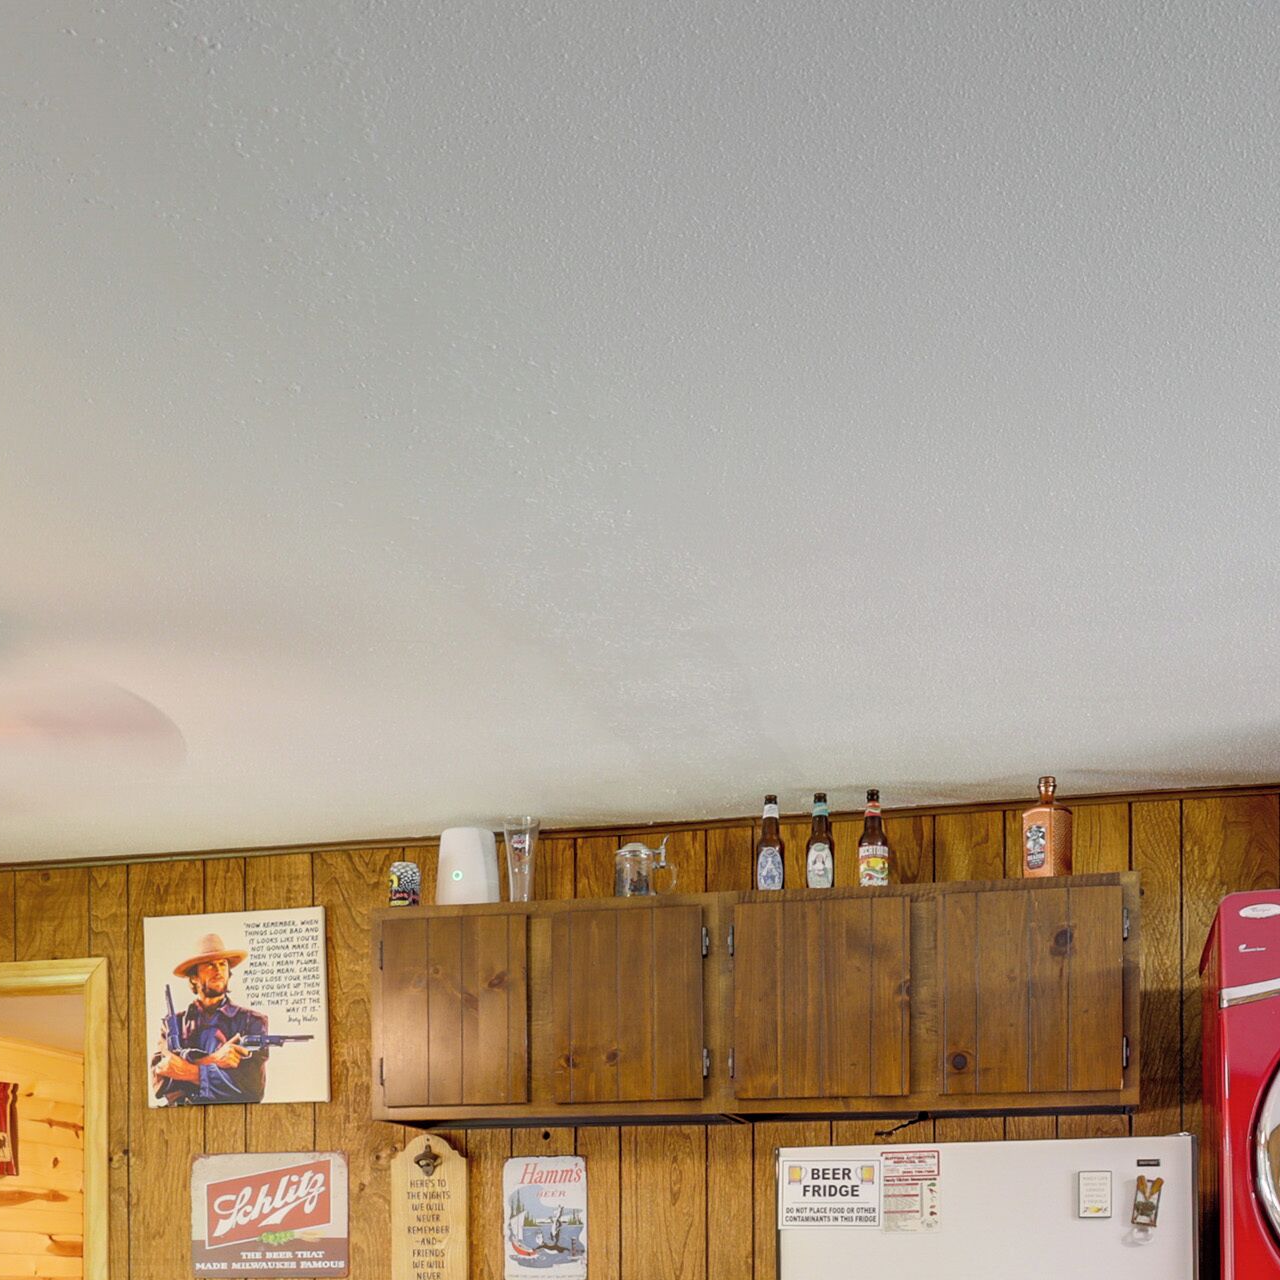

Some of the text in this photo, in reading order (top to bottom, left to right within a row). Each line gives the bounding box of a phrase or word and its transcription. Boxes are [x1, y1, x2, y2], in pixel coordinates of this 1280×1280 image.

[520, 1162, 583, 1185] Hamm's
[811, 1168, 852, 1181] BEER
[410, 1179, 447, 1188] HERE'S TO
[406, 1191, 451, 1200] THE NIGHTS
[536, 1190, 567, 1198] BEER
[802, 1185, 860, 1197] FRIDGE
[213, 1170, 326, 1237] Schlitz
[412, 1203, 445, 1211] WE WILL
[416, 1215, 441, 1223] NEVER
[407, 1226, 450, 1234] REMEMBER
[240, 1251, 325, 1260] THE BEER THAT
[412, 1249, 446, 1258] FRIENDS
[195, 1262, 228, 1270] MADE
[300, 1261, 345, 1269] FAMOUS
[413, 1261, 445, 1269] WE WILL
[417, 1272, 441, 1280] NEVER
